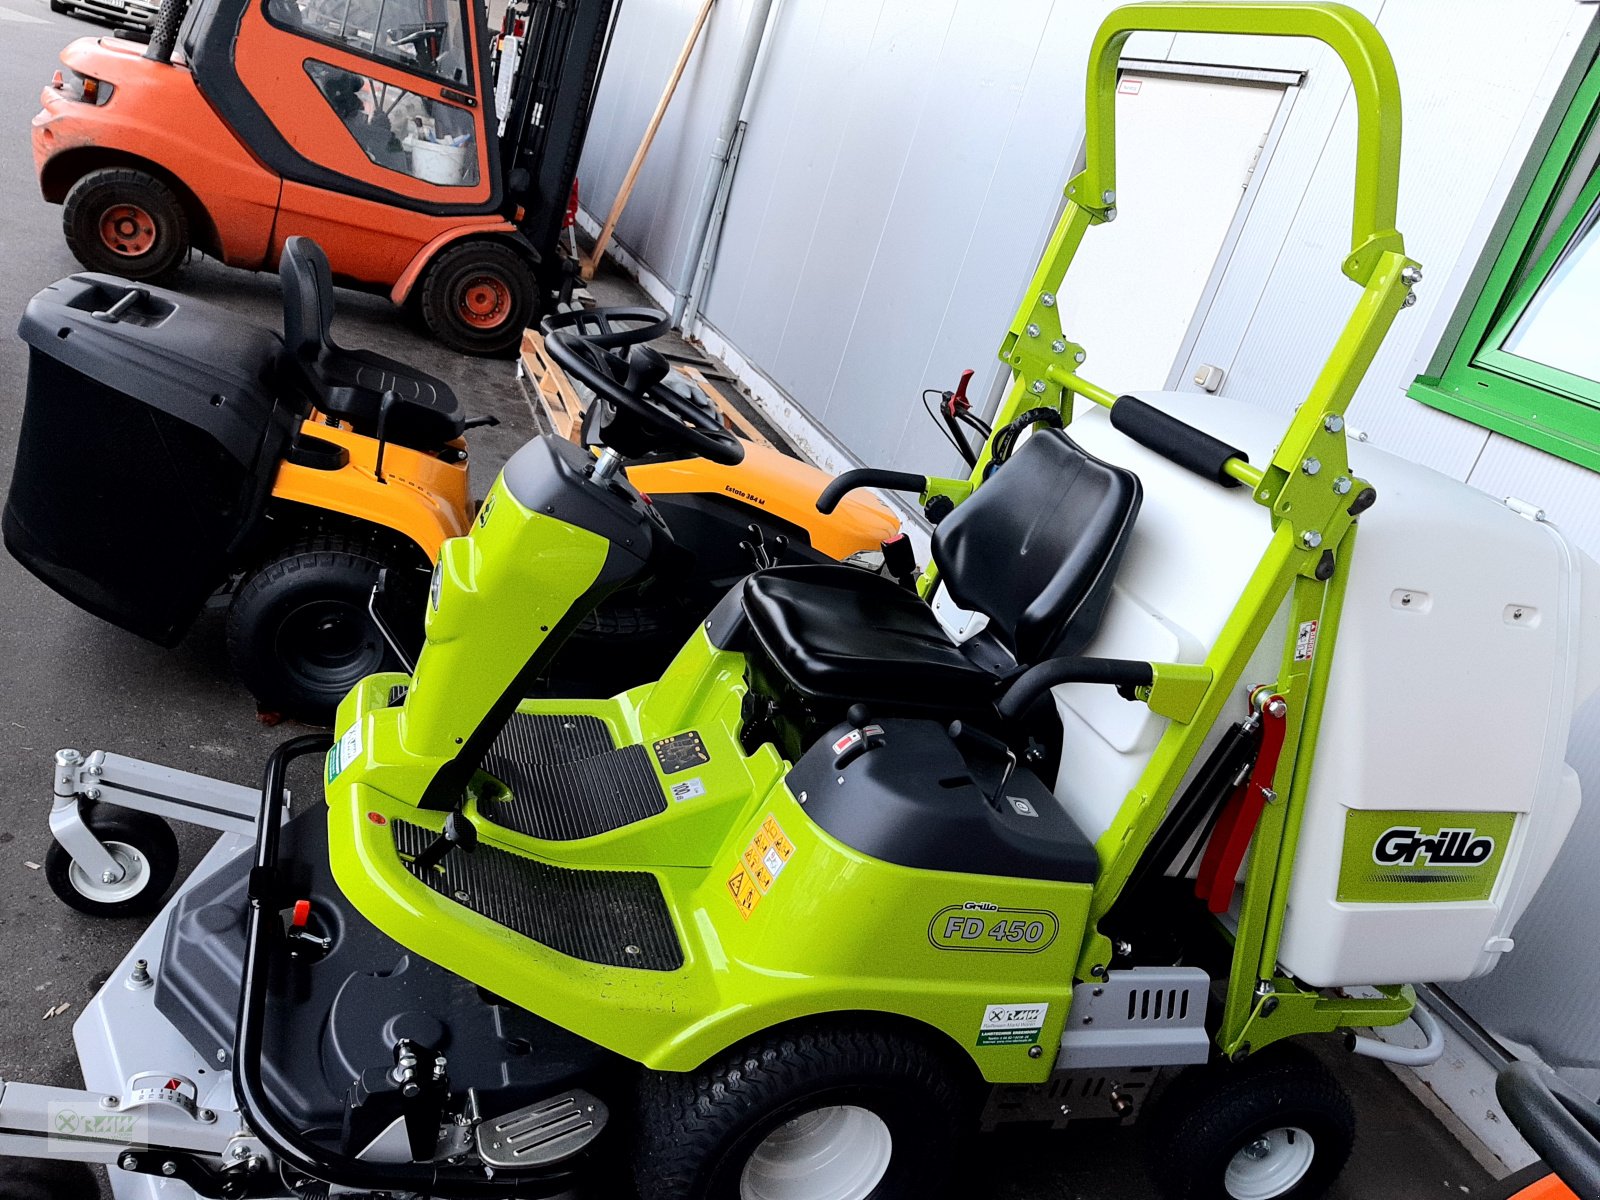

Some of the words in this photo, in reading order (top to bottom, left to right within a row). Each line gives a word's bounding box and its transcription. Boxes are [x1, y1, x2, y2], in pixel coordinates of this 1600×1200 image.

[725, 485, 746, 498] Estate
[746, 493, 758, 502] 384
[1373, 828, 1494, 865] Grillo
[963, 902, 998, 911] Grillo
[944, 916, 985, 939] FD
[988, 920, 1044, 943] 450
